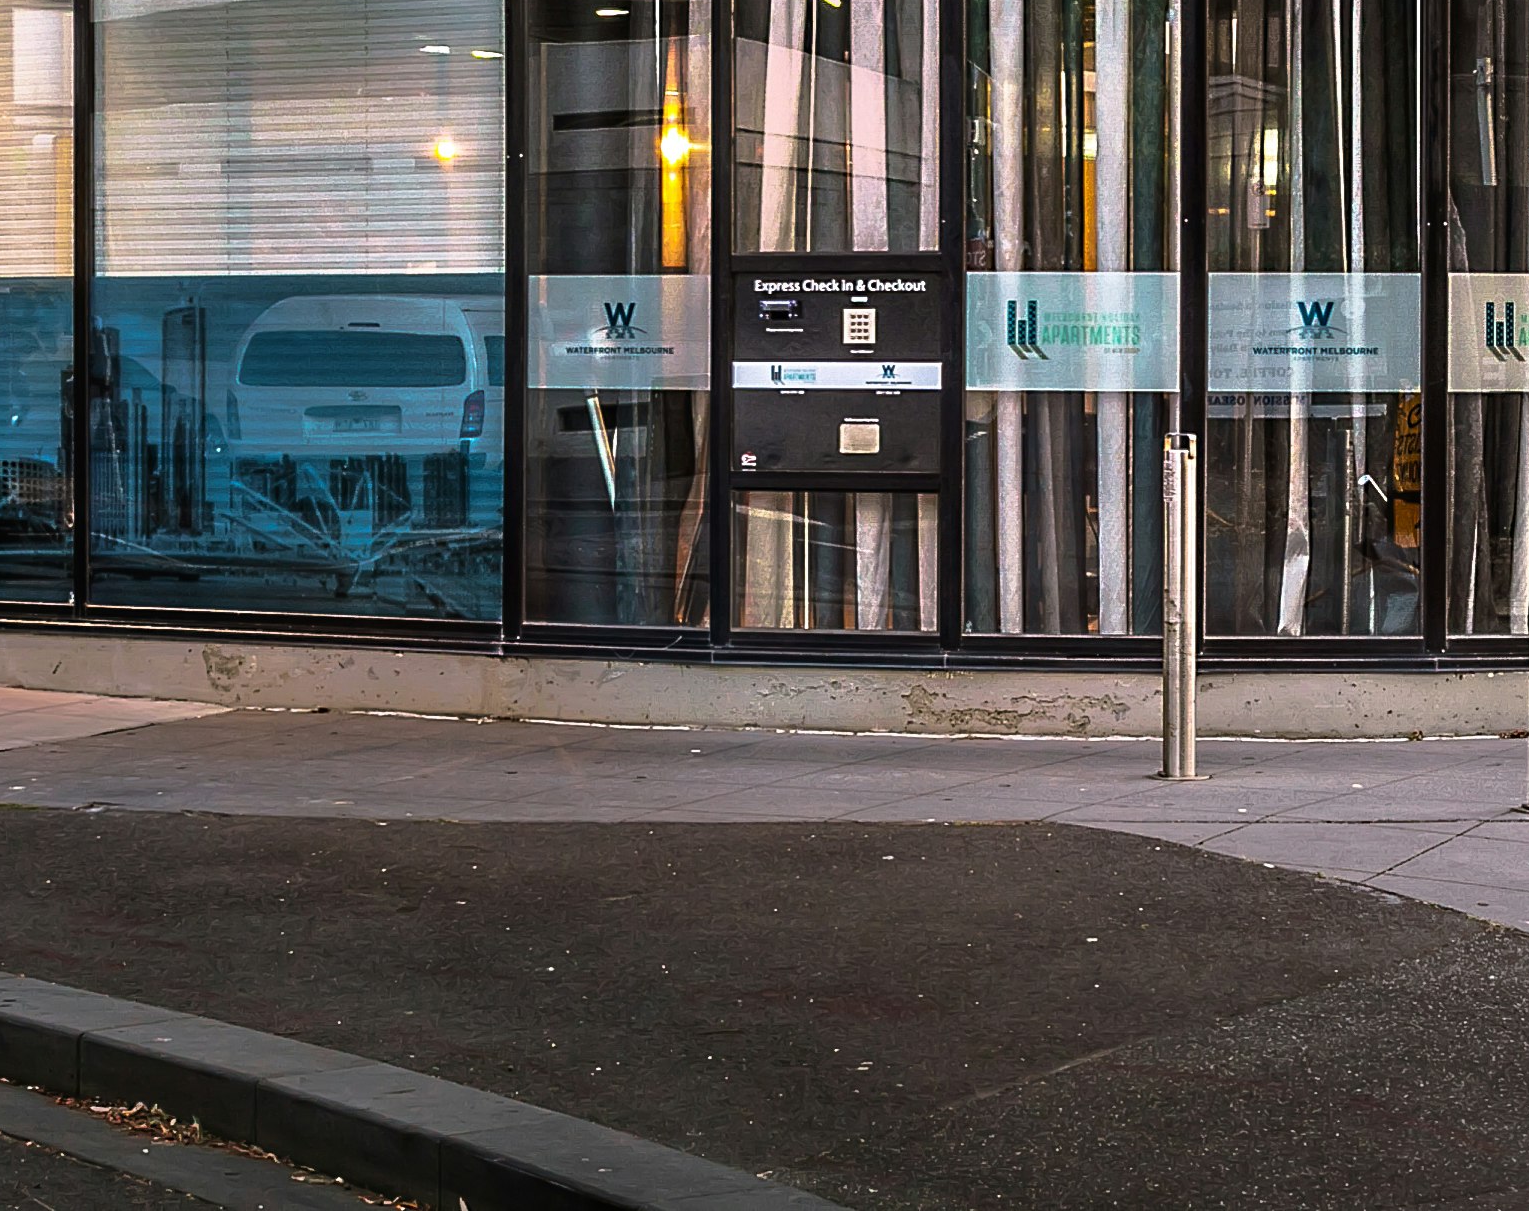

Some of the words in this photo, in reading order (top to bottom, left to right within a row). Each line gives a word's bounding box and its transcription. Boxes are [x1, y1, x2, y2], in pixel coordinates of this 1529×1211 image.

[754, 279, 801, 295] Express
[802, 279, 840, 292] Check
[856, 279, 866, 292] &
[867, 279, 926, 292] Checkout
[1297, 301, 1335, 327] W
[1041, 325, 1141, 346] APARTMENTS
[565, 346, 621, 355] WATERFRONT
[623, 346, 675, 355] MELBOURNE
[1252, 347, 1318, 356] WATERFRONT
[1320, 347, 1379, 356] MELBOURNE
